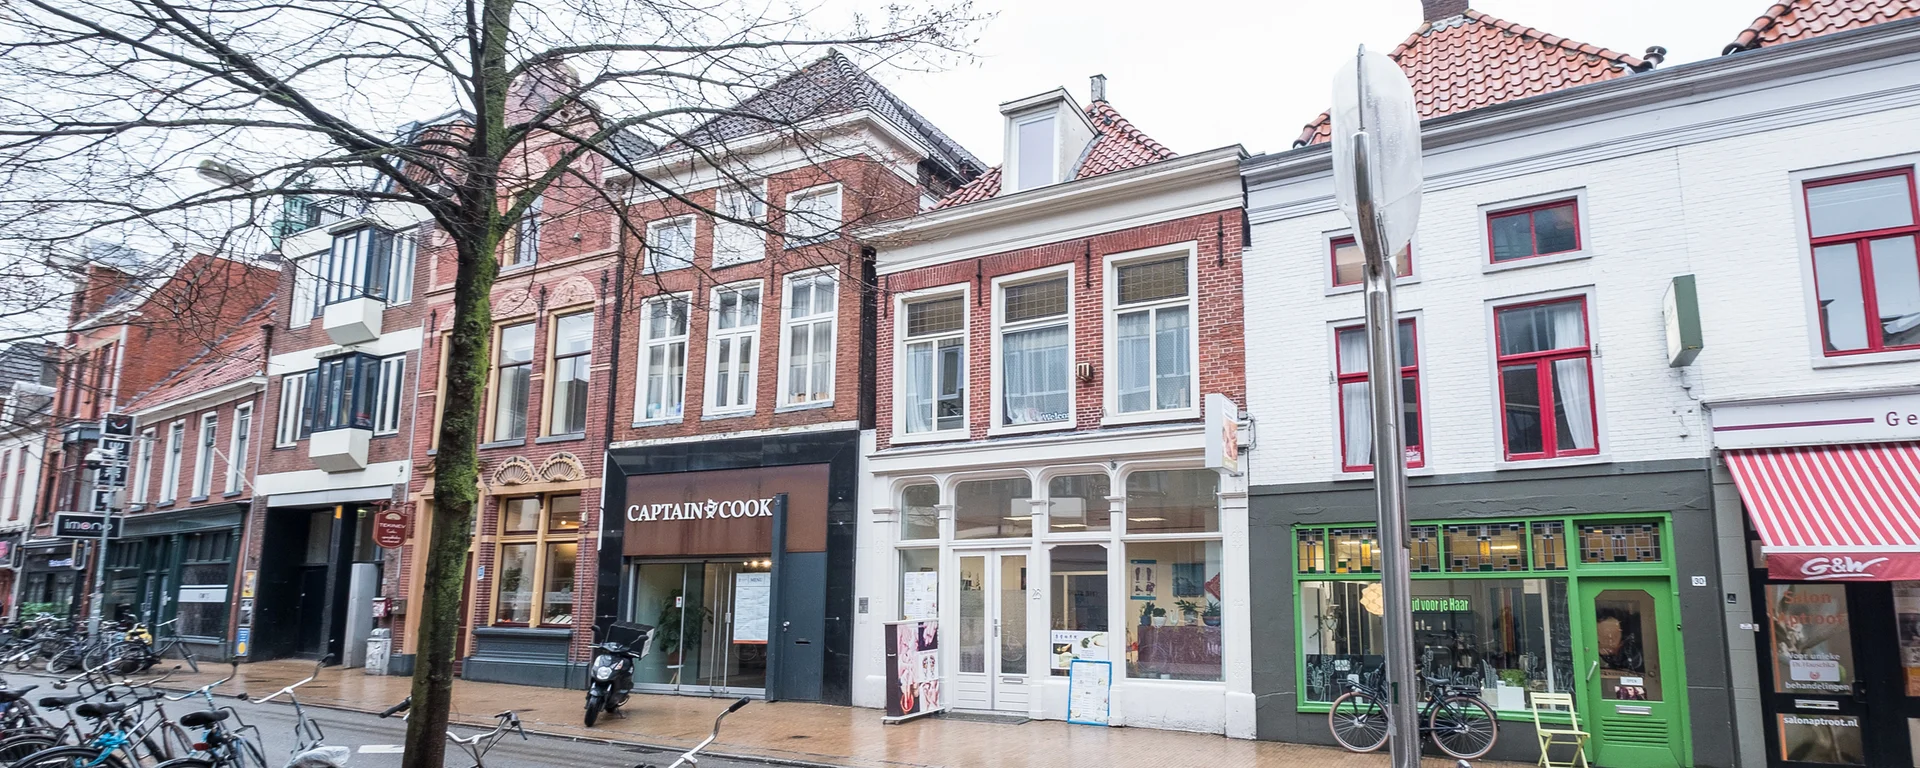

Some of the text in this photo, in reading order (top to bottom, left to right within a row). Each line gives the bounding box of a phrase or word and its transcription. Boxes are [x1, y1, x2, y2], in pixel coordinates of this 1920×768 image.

[1886, 411, 1918, 426] Ge
[627, 498, 773, 521] CAPTAIN COOK
[1801, 556, 1889, 577] G&W
[1694, 577, 1705, 585] 30
[1421, 600, 1438, 611] voor
[1440, 597, 1448, 612] je
[1450, 598, 1468, 611] Haar
[1784, 591, 1832, 604] Salon
[1785, 682, 1850, 692] behandelingen
[1784, 716, 1859, 727] salonaptroot.nl
